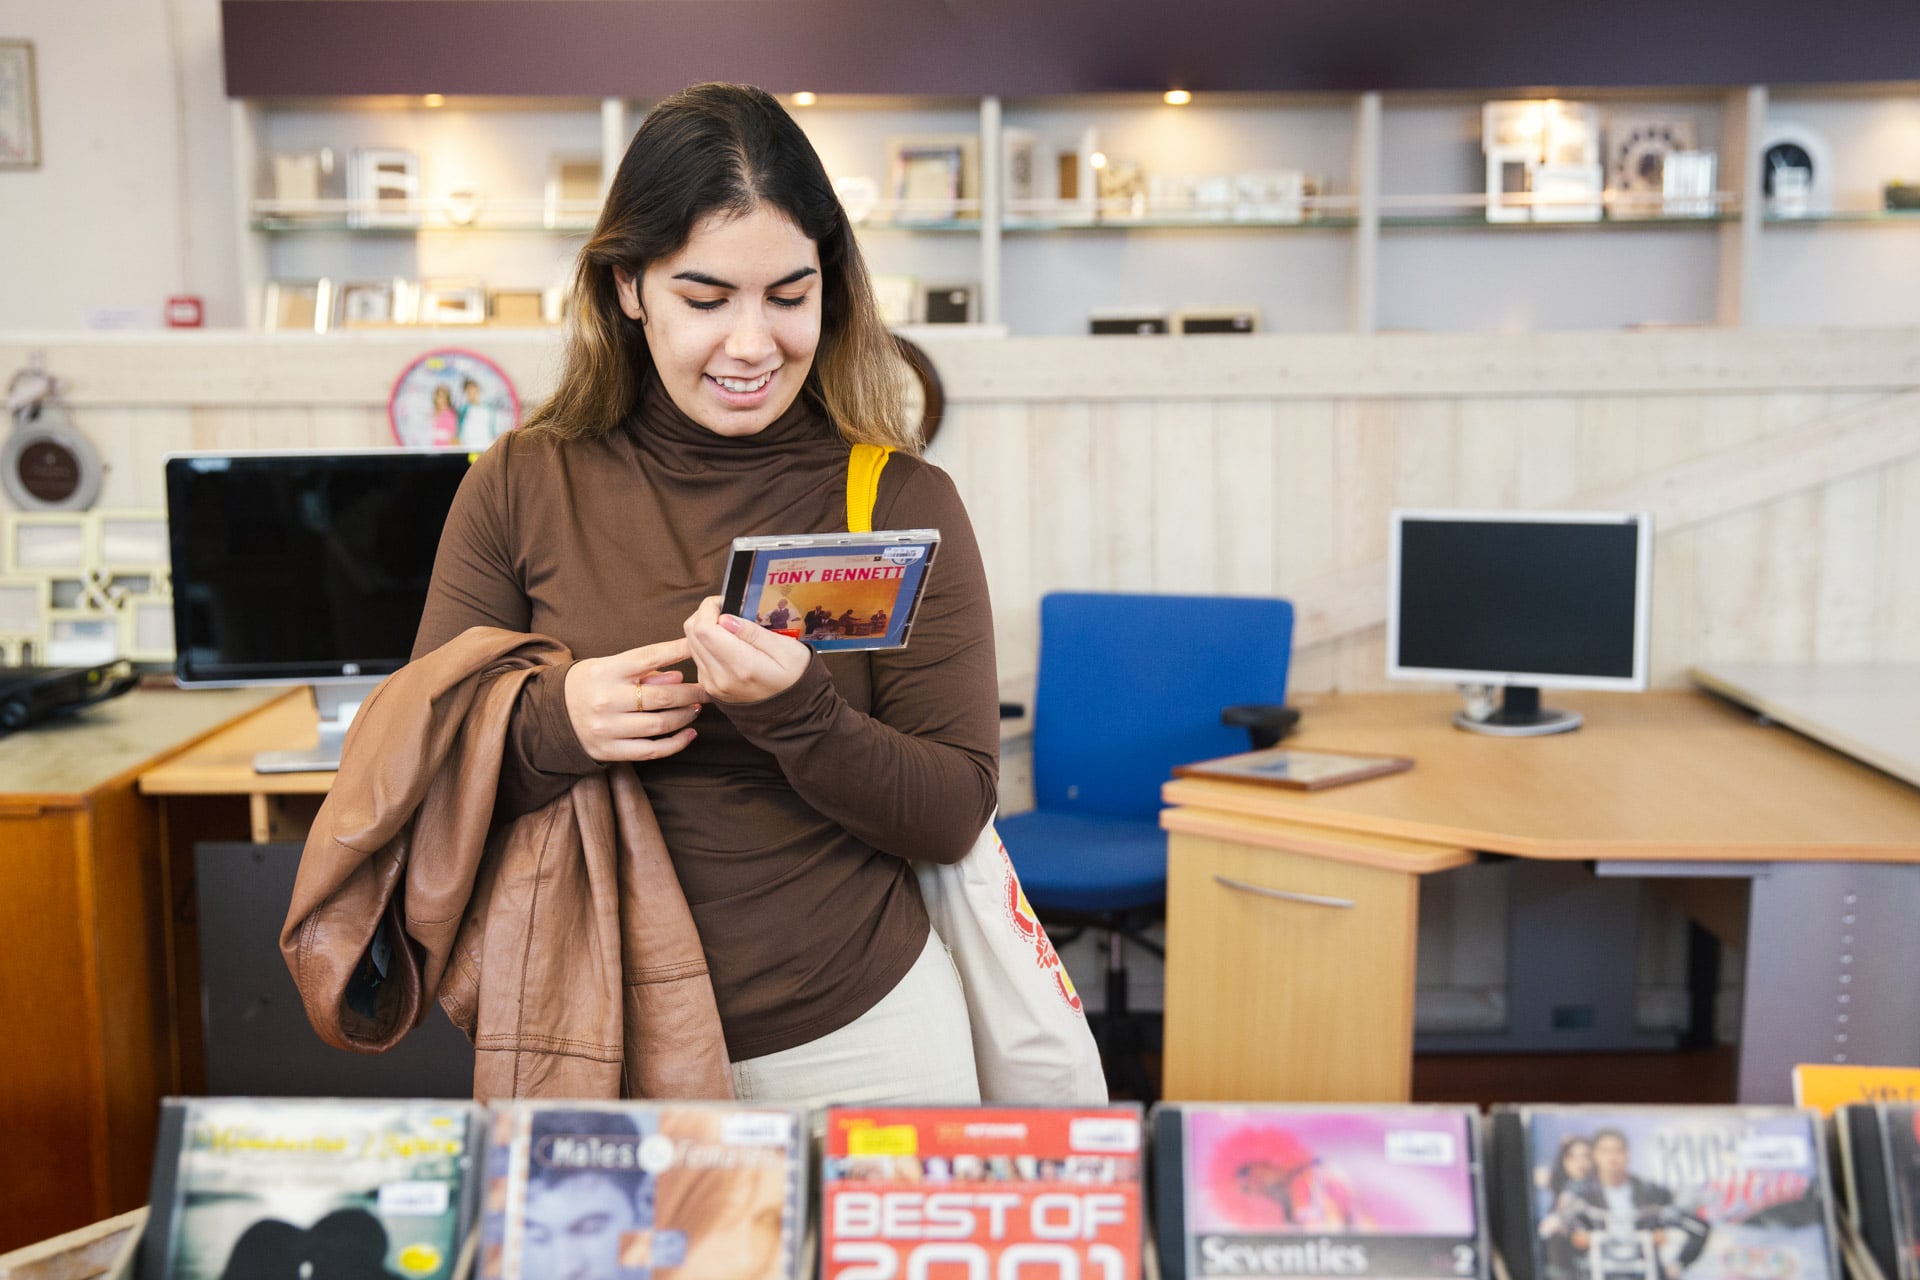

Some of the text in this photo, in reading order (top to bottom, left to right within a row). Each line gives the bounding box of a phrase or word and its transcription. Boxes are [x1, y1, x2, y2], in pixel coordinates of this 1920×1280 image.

[768, 566, 905, 585] TONY BENNETT
[552, 1137, 635, 1168] Males
[833, 1191, 1127, 1240] BEST OF
[1200, 1236, 1476, 1275] Seventies 2
